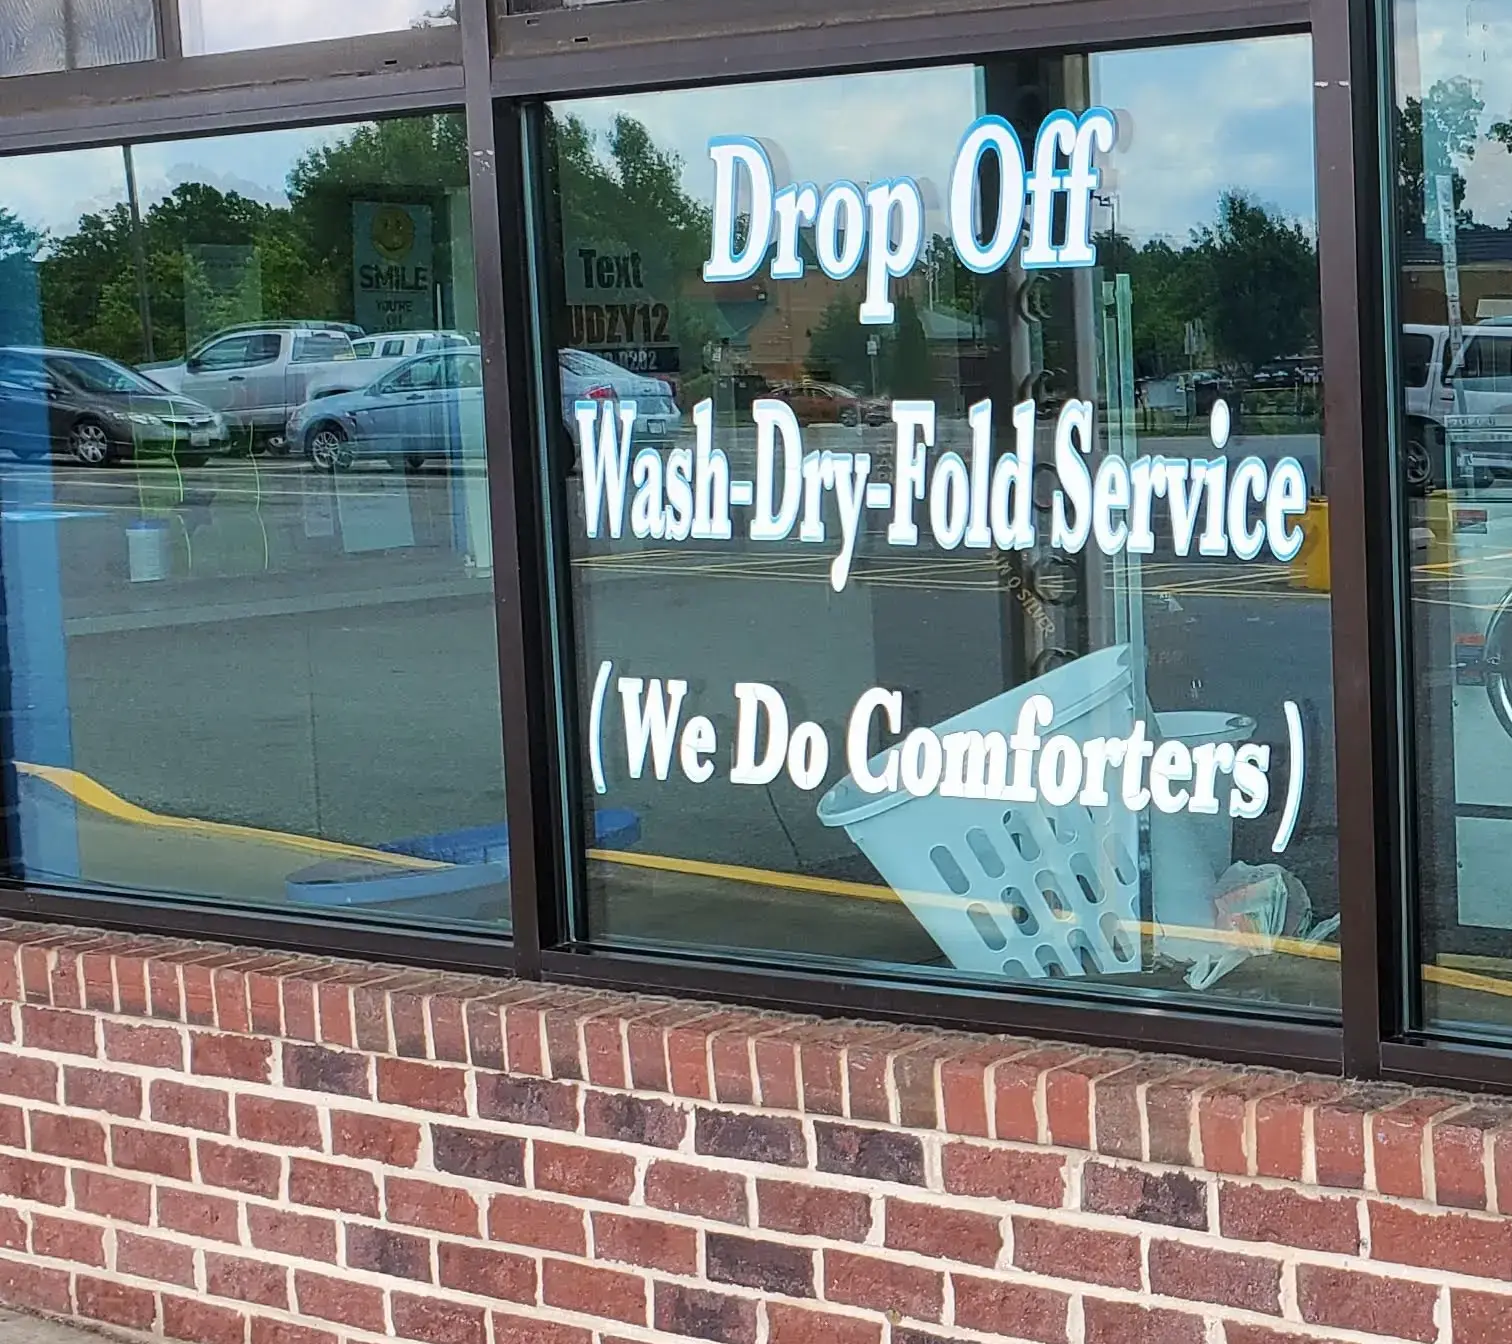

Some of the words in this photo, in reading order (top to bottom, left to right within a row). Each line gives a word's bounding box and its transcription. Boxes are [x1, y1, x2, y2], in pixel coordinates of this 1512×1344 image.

[359, 264, 428, 290] SMILE
[578, 248, 644, 288] Text
[703, 135, 926, 325] Drop
[949, 105, 1119, 274] Off
[574, 398, 1036, 593] Wash-Dry-Fold
[1052, 398, 1307, 562] Service
[731, 682, 829, 791] Do
[847, 687, 1307, 853] Comforters)
